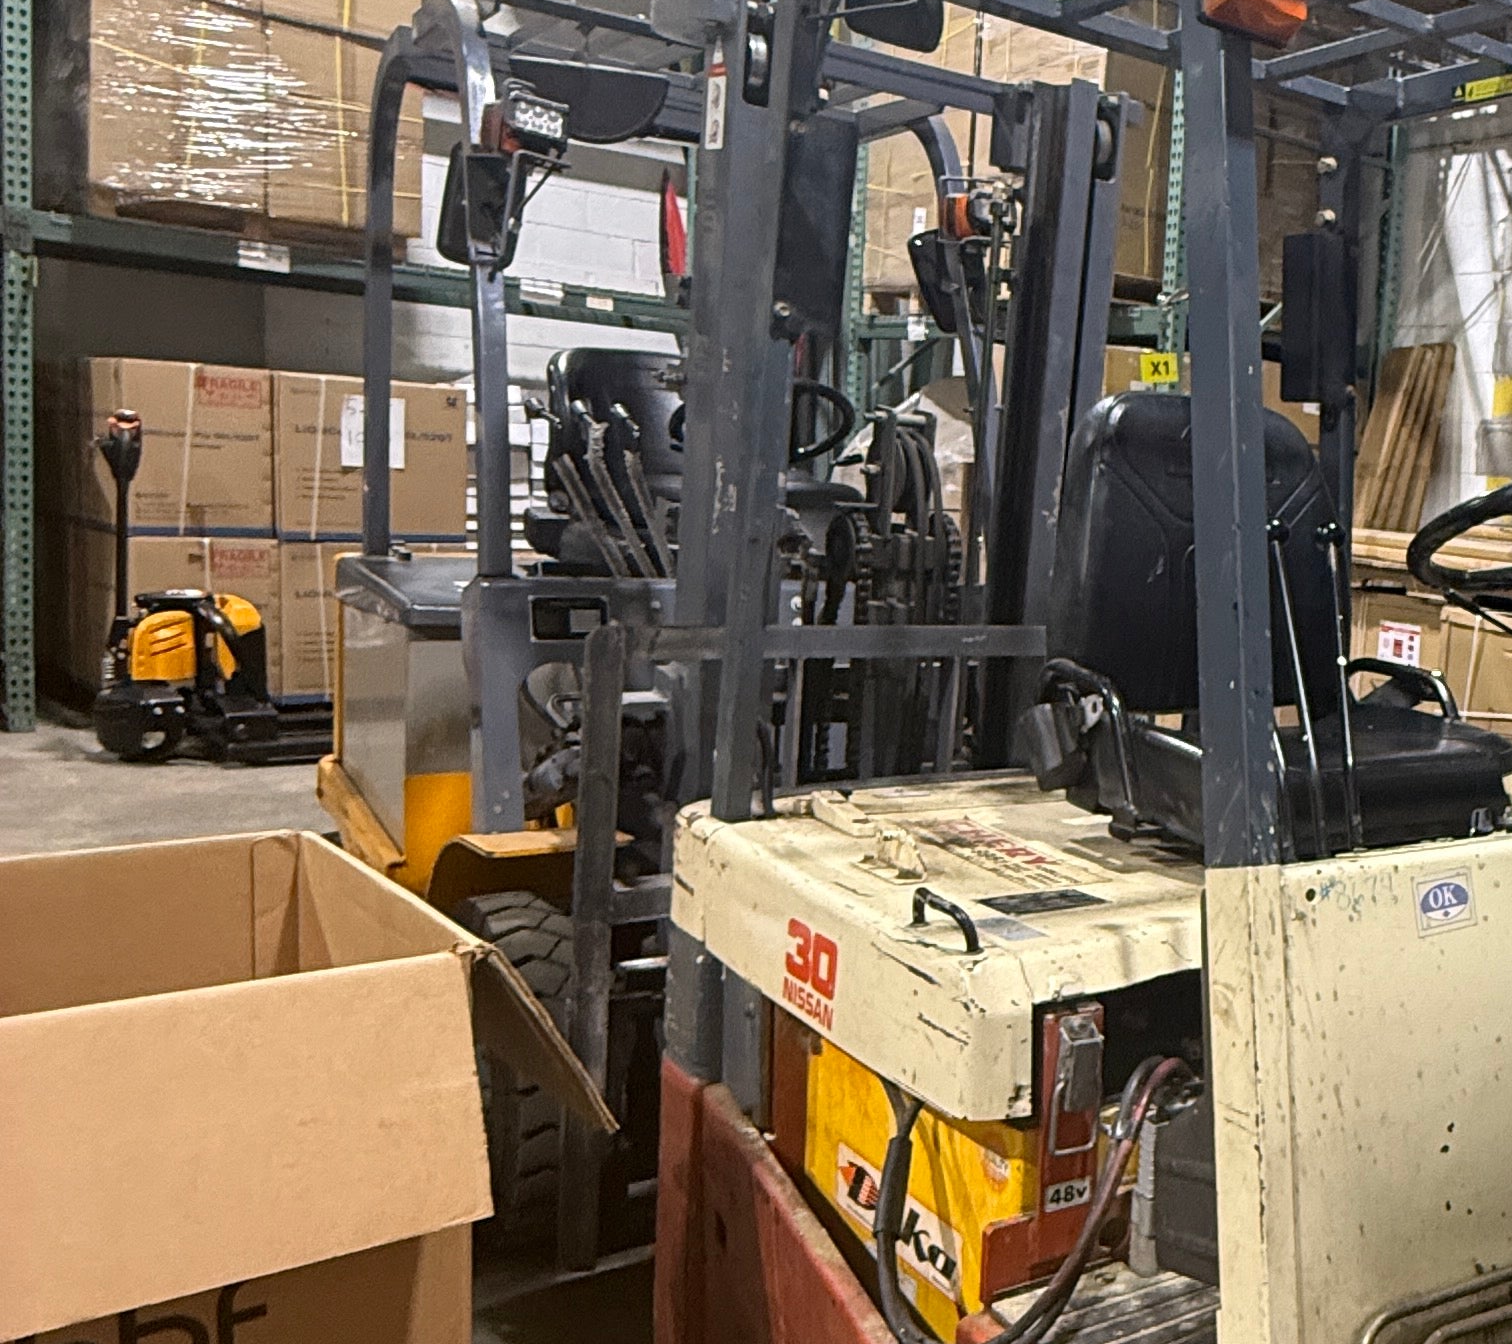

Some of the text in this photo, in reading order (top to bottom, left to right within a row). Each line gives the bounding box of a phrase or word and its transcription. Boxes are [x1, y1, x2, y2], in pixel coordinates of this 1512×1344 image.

[1150, 360, 1170, 376] X1
[1428, 884, 1458, 909] OK
[785, 917, 838, 1001] 30
[782, 975, 834, 1032] NISSAN
[846, 1160, 957, 1280] Dka
